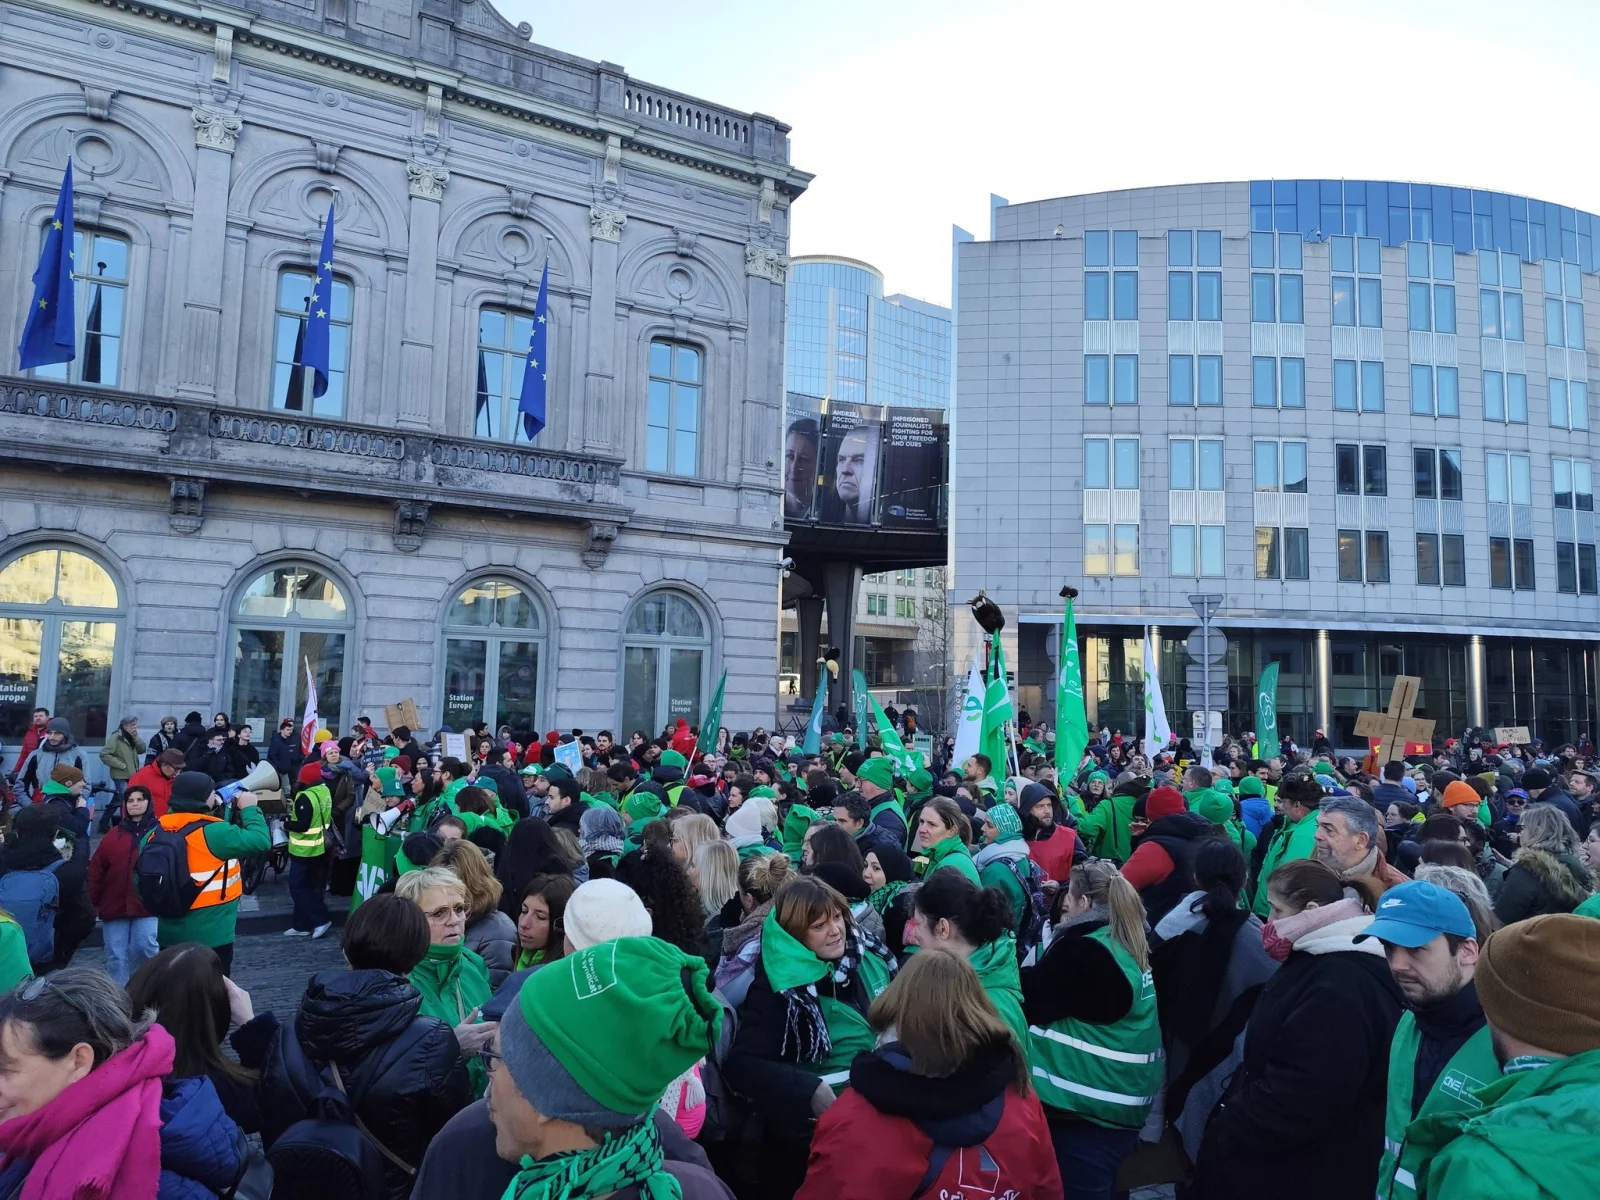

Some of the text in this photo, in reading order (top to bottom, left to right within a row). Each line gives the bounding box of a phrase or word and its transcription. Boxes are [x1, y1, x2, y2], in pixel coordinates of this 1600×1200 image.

[832, 409, 860, 418] ANDRZEJ
[832, 415, 864, 424] POCZOBUT
[892, 415, 929, 423] IMPRISONED
[831, 422, 854, 430] BELARUS
[449, 693, 475, 701] Station
[448, 701, 473, 711] Europe
[671, 705, 691, 714] Europe
[582, 959, 598, 994] syndicat
